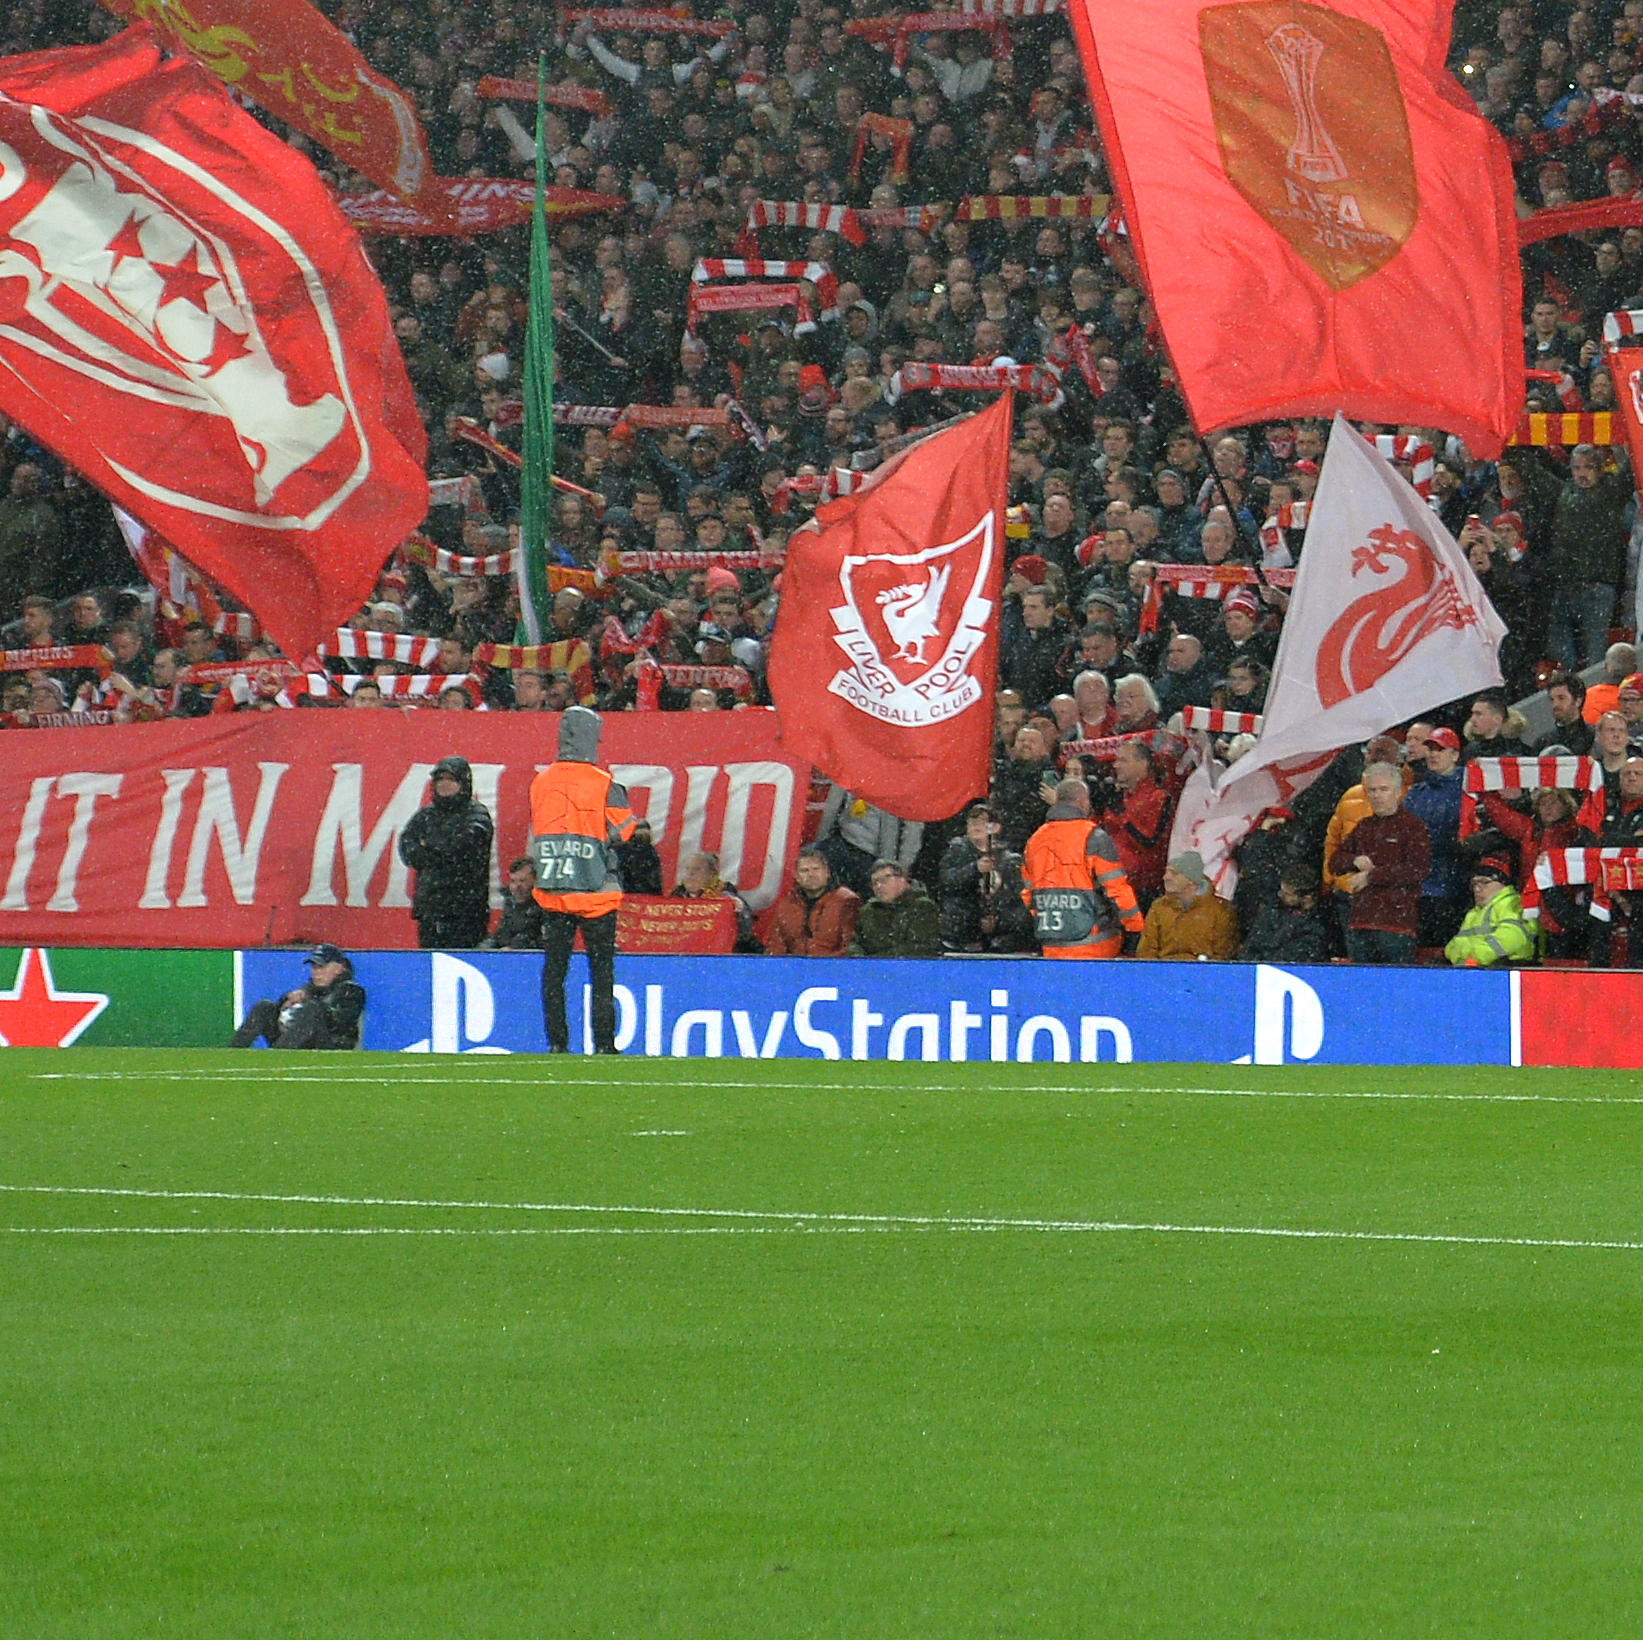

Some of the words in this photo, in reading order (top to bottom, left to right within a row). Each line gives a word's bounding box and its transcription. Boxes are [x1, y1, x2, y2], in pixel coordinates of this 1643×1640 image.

[836, 675, 924, 724] FOOTBALL
[928, 684, 976, 721] CLUB
[846, 636, 897, 700] LIVER
[913, 638, 976, 702] POOL
[2, 773, 124, 912] IT
[138, 761, 291, 911] IN
[300, 761, 796, 913] MRID
[585, 982, 1133, 1063] PlayStation
